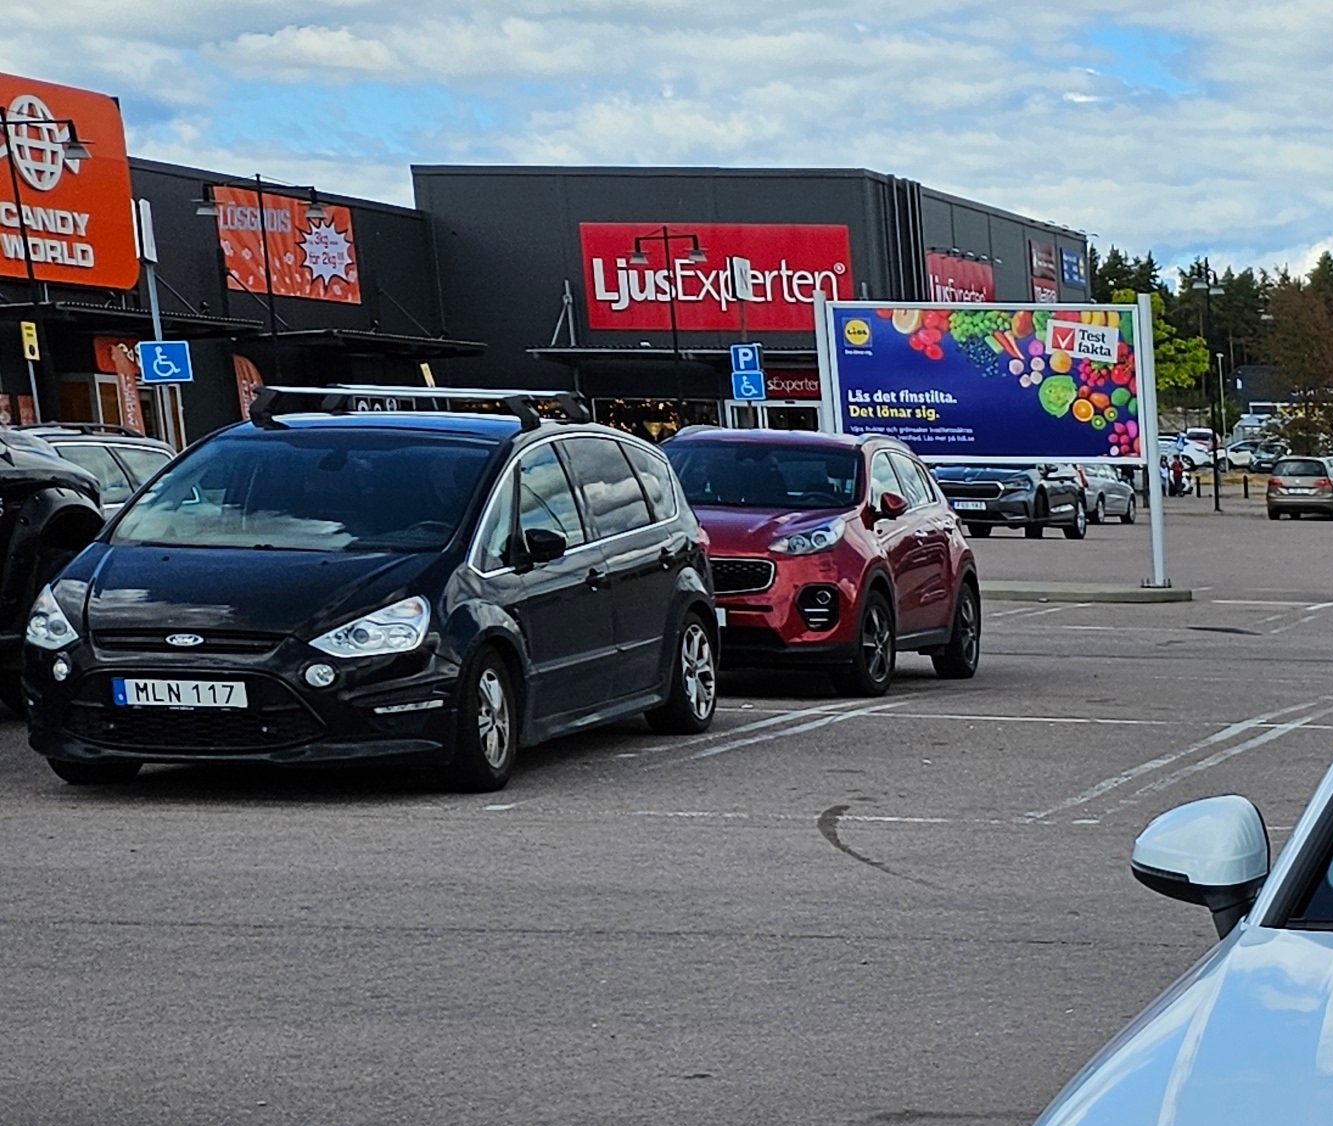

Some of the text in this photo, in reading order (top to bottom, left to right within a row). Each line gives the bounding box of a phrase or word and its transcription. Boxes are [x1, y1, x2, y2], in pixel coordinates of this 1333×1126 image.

[0, 201, 89, 237] CANDY
[2, 233, 95, 268] WORLD
[1079, 328, 1106, 344] Test
[1078, 341, 1112, 357] fakta
[738, 348, 753, 369] P
[847, 389, 958, 404] Läs det finstilta.
[849, 405, 940, 421] Det lönar sig.
[135, 682, 235, 704] MLN 117
